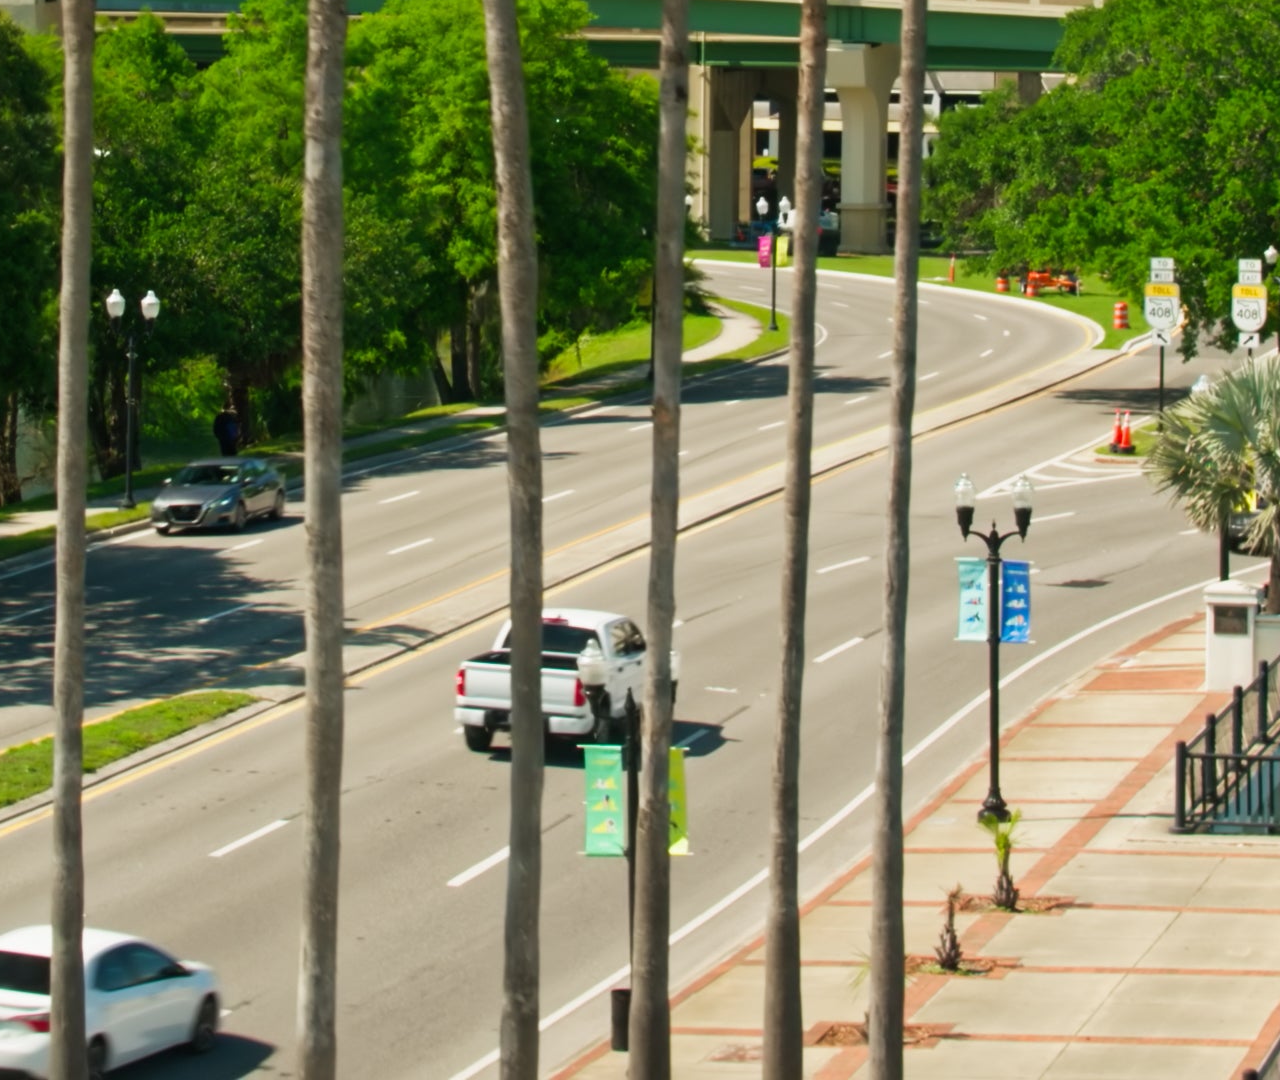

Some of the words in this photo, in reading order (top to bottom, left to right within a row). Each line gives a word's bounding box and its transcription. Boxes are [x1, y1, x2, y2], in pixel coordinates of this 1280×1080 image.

[1152, 286, 1172, 295] TOLL
[1240, 287, 1258, 297] TOLL
[1149, 307, 1171, 318] 408
[1237, 308, 1258, 320] 408
